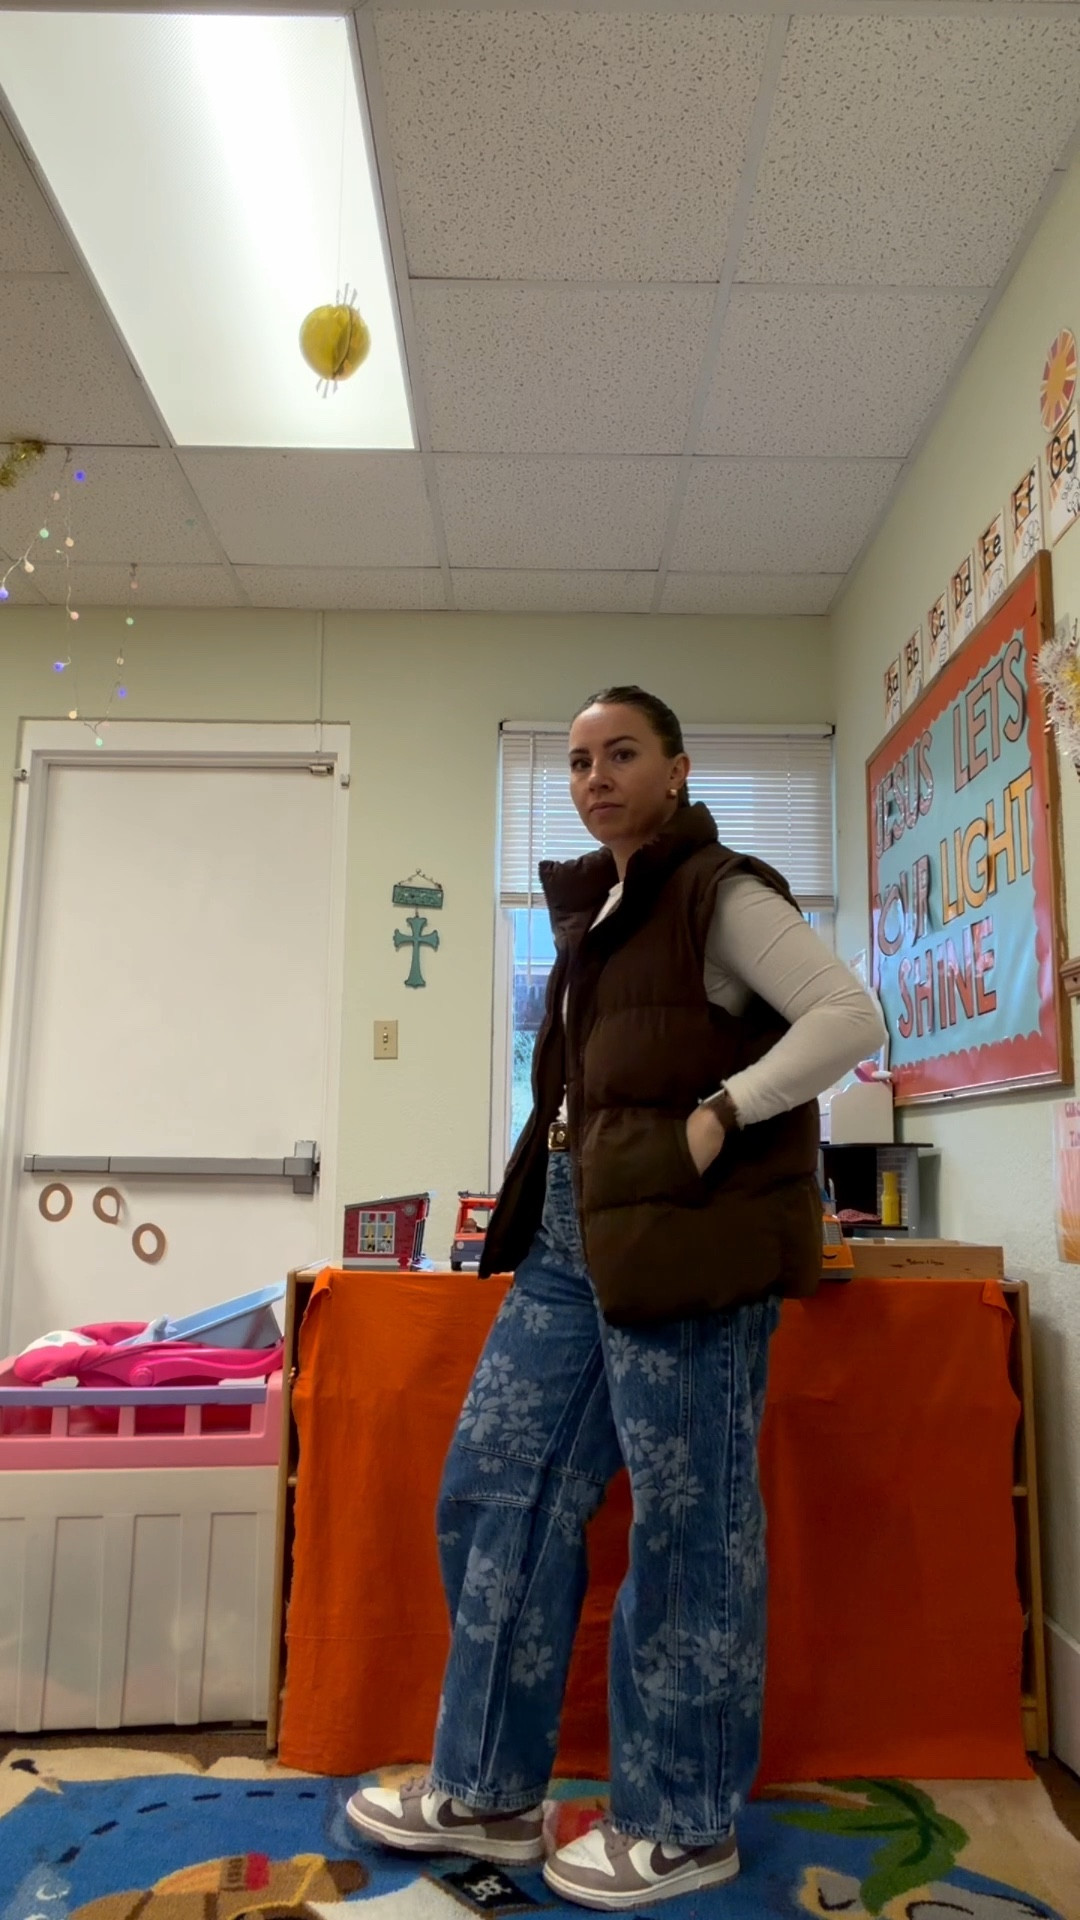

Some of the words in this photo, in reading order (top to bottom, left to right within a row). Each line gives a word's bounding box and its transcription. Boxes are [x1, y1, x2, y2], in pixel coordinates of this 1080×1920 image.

[1050, 429, 1077, 480] Gg
[1014, 469, 1035, 529] Ff
[982, 528, 1001, 571] Ee
[954, 557, 972, 610] Dd
[932, 607, 945, 640] Cc
[906, 637, 919, 676] Bb
[887, 670, 899, 703] Aa
[875, 730, 934, 859] JESUS
[953, 638, 1026, 793] LETS
[940, 767, 1033, 925] LIGHT
[898, 915, 997, 1038] SHINE
